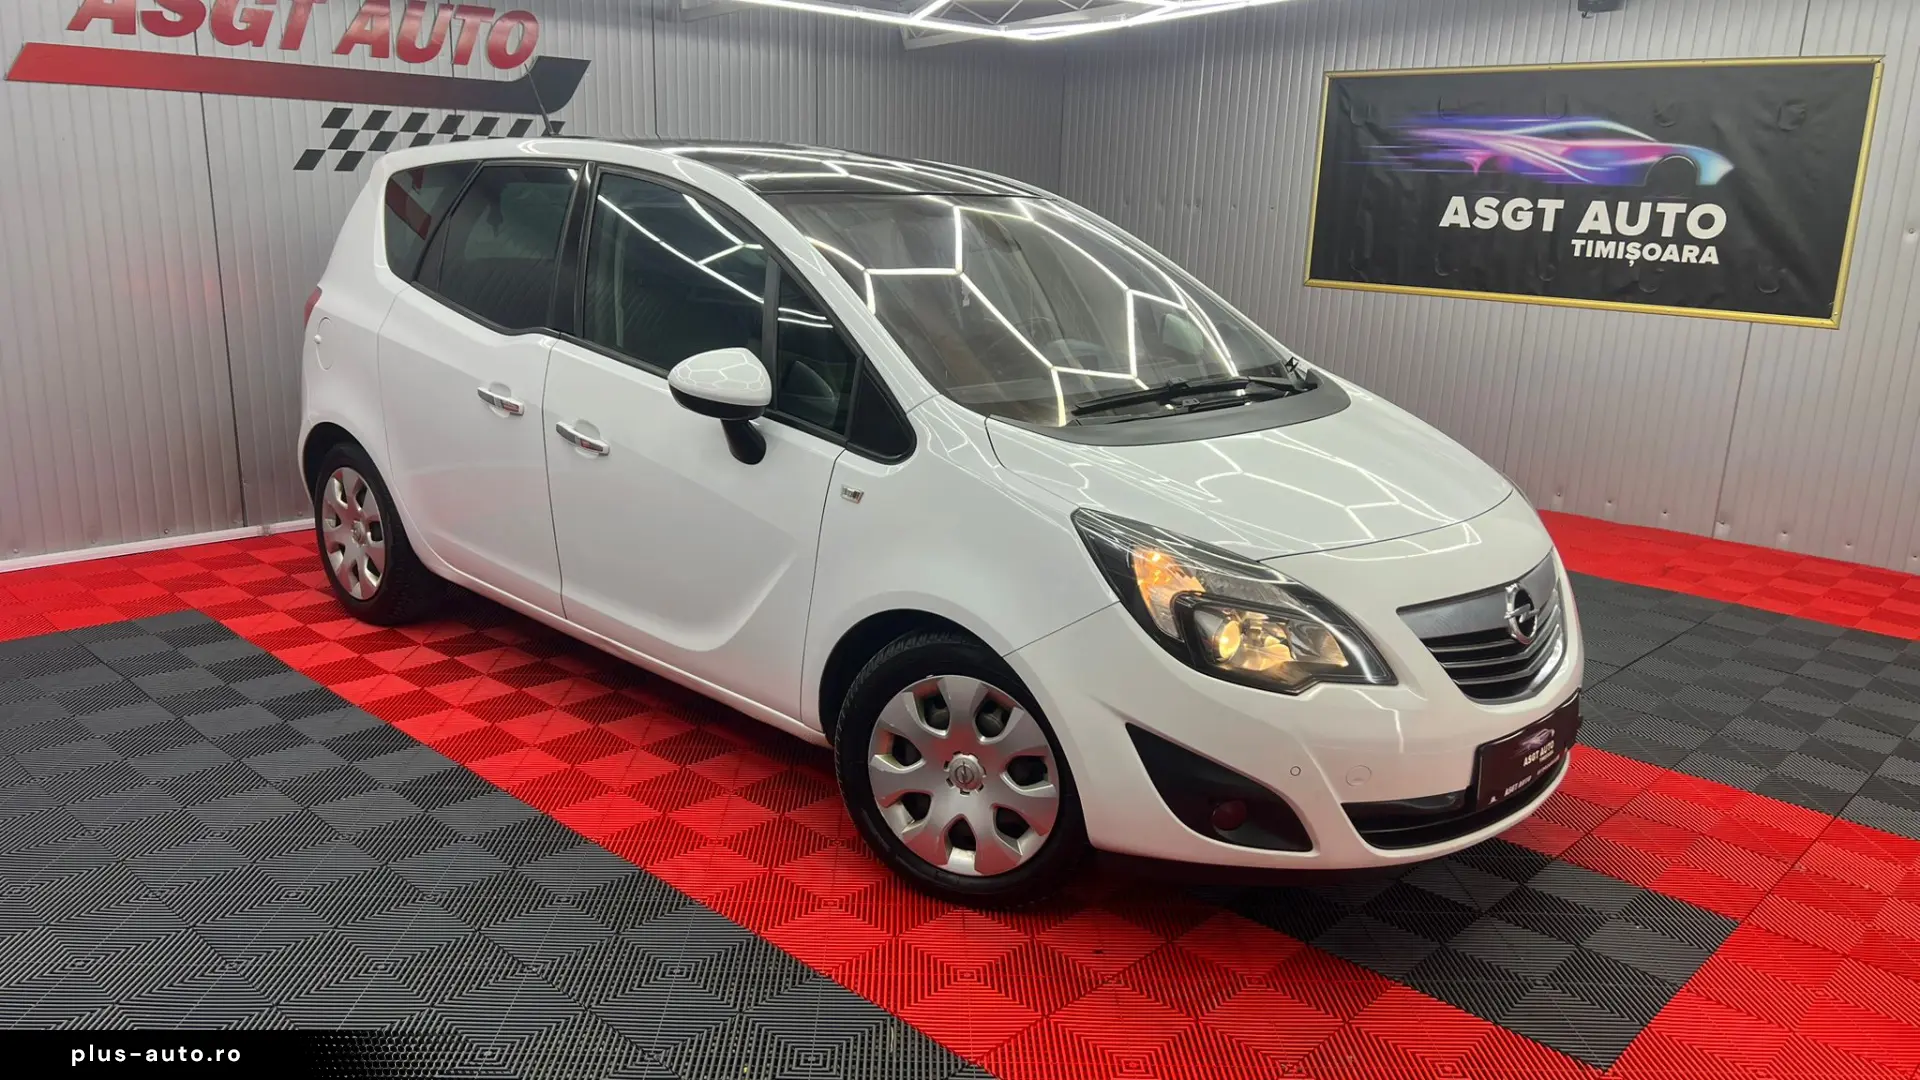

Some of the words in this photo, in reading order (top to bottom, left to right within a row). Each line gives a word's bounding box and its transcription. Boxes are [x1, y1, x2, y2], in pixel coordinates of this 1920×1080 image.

[331, 0, 539, 69] AUTO
[1439, 196, 1564, 231] ASGT
[1576, 200, 1727, 239] AUTO
[1571, 239, 1720, 267] TIMIȘOARA
[1523, 750, 1539, 766] ASGT
[1540, 740, 1555, 756] AUTO
